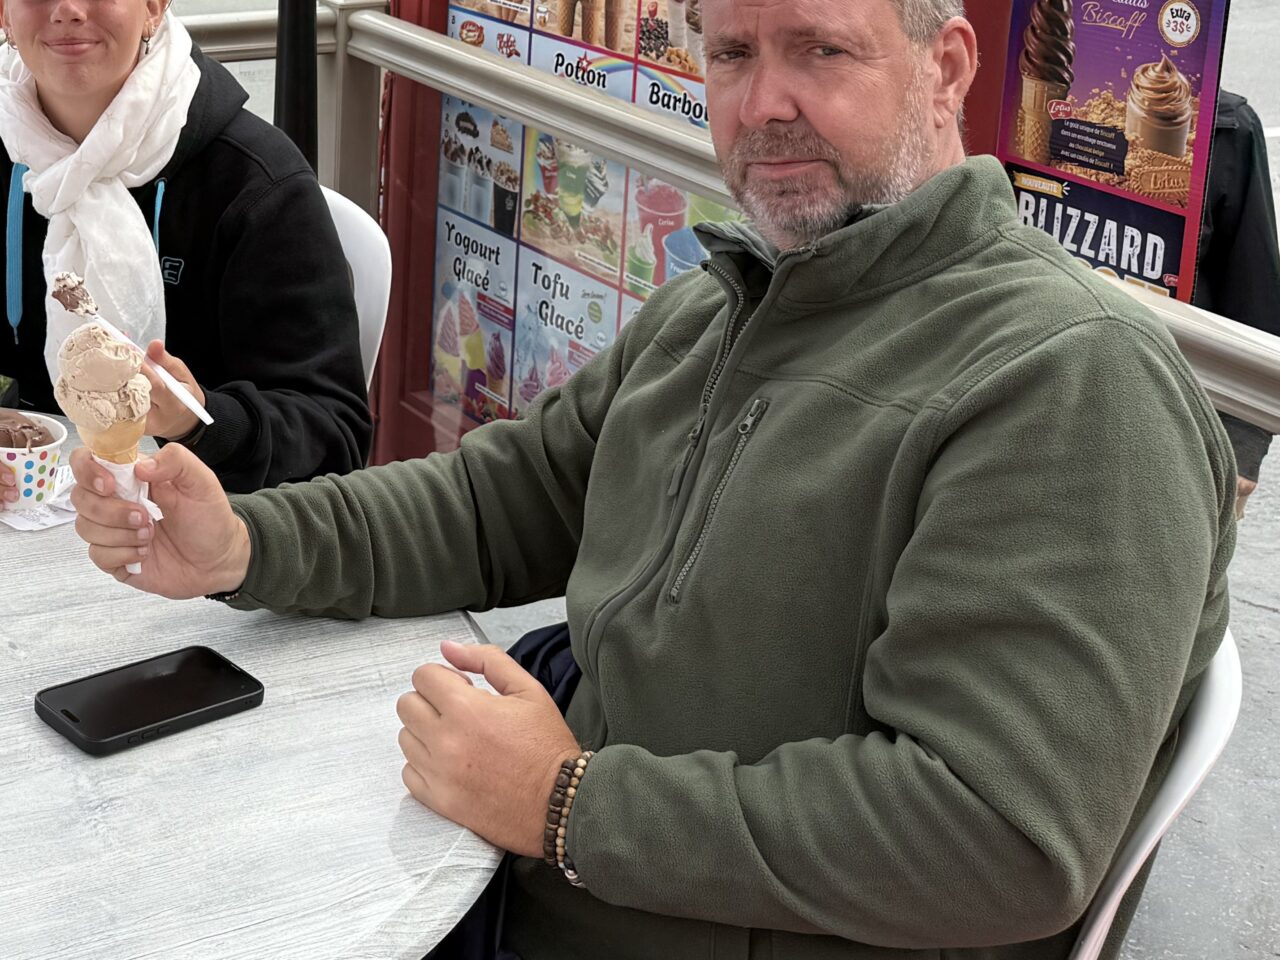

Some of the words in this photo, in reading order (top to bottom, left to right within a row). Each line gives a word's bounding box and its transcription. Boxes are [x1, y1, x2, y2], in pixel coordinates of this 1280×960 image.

[1081, 1, 1147, 39] Biscoff
[1170, 7, 1191, 22] Extra
[1171, 20, 1185, 34] 3$
[554, 52, 607, 89] Potion
[1050, 101, 1071, 114] Lotus
[1150, 172, 1184, 190] Lotus
[445, 221, 501, 266] Yogourt
[453, 256, 490, 292] Glacé
[531, 262, 570, 300] Tofu
[538, 300, 584, 340] Glacé
